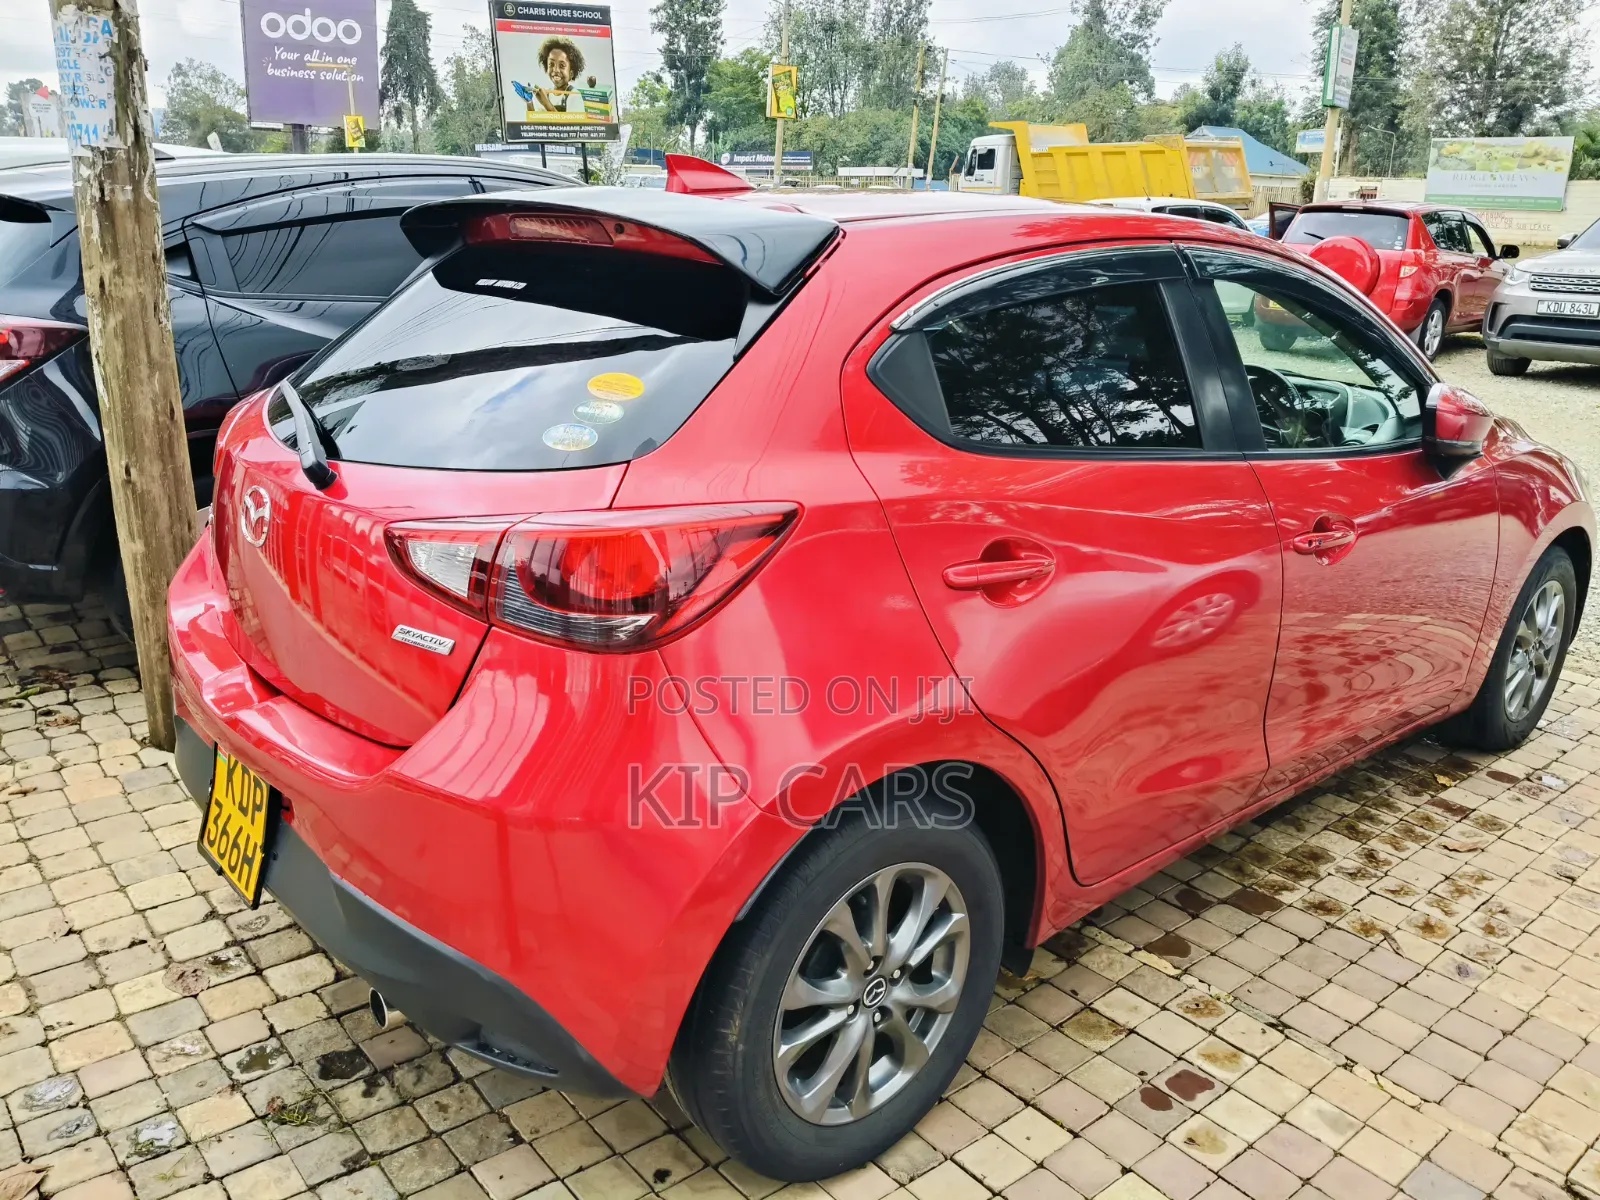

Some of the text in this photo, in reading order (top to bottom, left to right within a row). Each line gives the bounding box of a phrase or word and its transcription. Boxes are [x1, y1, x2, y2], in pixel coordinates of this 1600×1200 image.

[517, 6, 603, 20] CHARIS HOUSE SCHOOL
[260, 8, 362, 45] odoo
[274, 45, 358, 65] Your all in one
[267, 62, 364, 82] business soluton
[733, 153, 777, 164] Impact Motor
[1452, 173, 1486, 182] RIDGE
[1530, 223, 1552, 231] LEASE
[1546, 301, 1595, 315] KDU 843L
[398, 627, 448, 647] SKYACTIV
[225, 752, 264, 827] KDP
[206, 797, 258, 893] 366H
